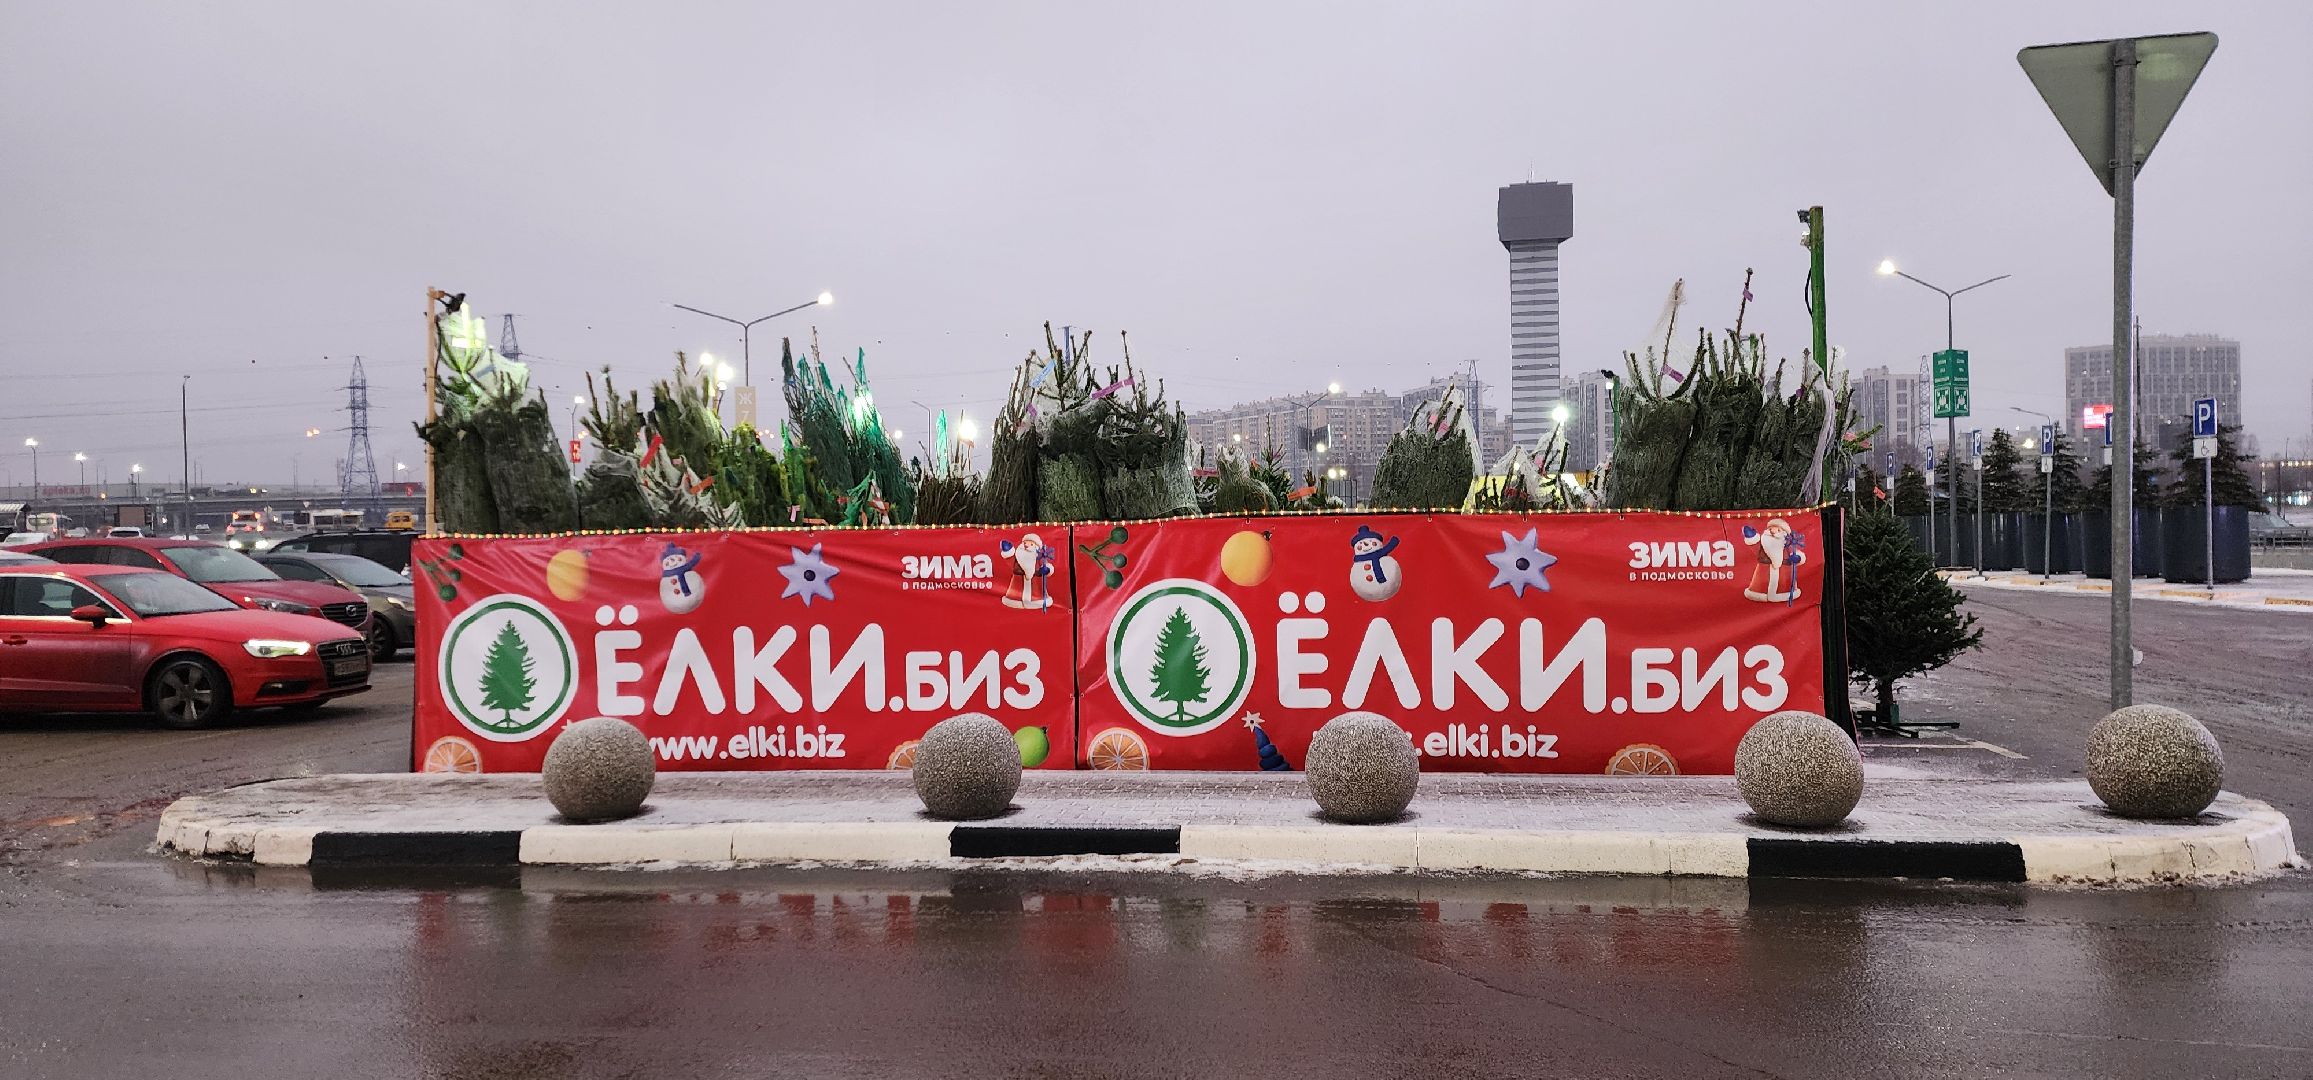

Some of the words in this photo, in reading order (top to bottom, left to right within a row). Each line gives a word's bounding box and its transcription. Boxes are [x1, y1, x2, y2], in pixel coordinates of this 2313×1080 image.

[2198, 403, 2211, 433] P
[2043, 428, 2052, 452] P
[901, 554, 993, 579] зима
[1628, 541, 1735, 568] зима
[595, 605, 1045, 716] ЁЛКИ.БИЗ
[1277, 591, 1789, 714] ЁЛКИ.БИЗ
[649, 724, 846, 761] ww.elki.biz
